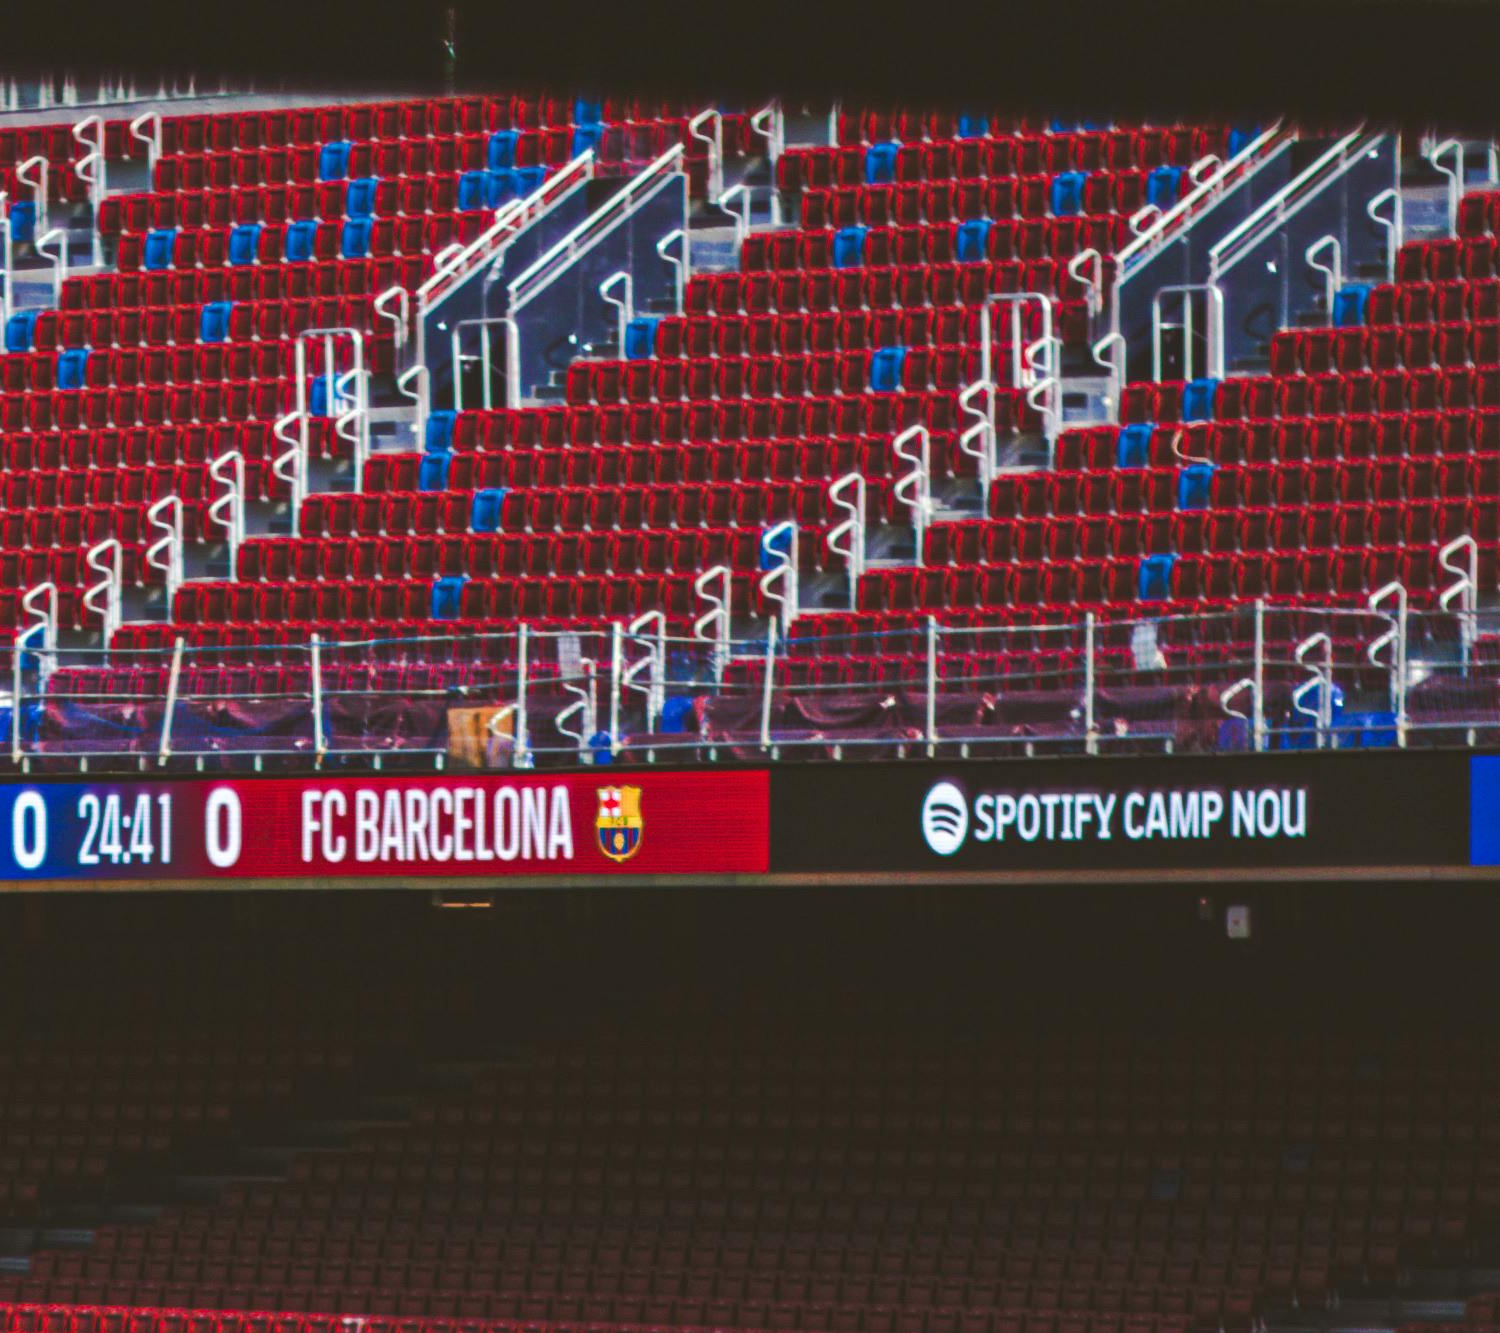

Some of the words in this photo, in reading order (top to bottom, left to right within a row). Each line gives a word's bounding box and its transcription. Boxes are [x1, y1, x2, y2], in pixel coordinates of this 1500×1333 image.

[12, 791, 47, 869] 0
[78, 793, 172, 864] 24:41
[205, 787, 242, 868] 0
[302, 789, 346, 863] FC
[355, 785, 574, 862] BARCELONA
[974, 792, 1117, 842] SPOTIFY
[1123, 788, 1223, 839] CAMP
[1230, 788, 1307, 838] NOU
